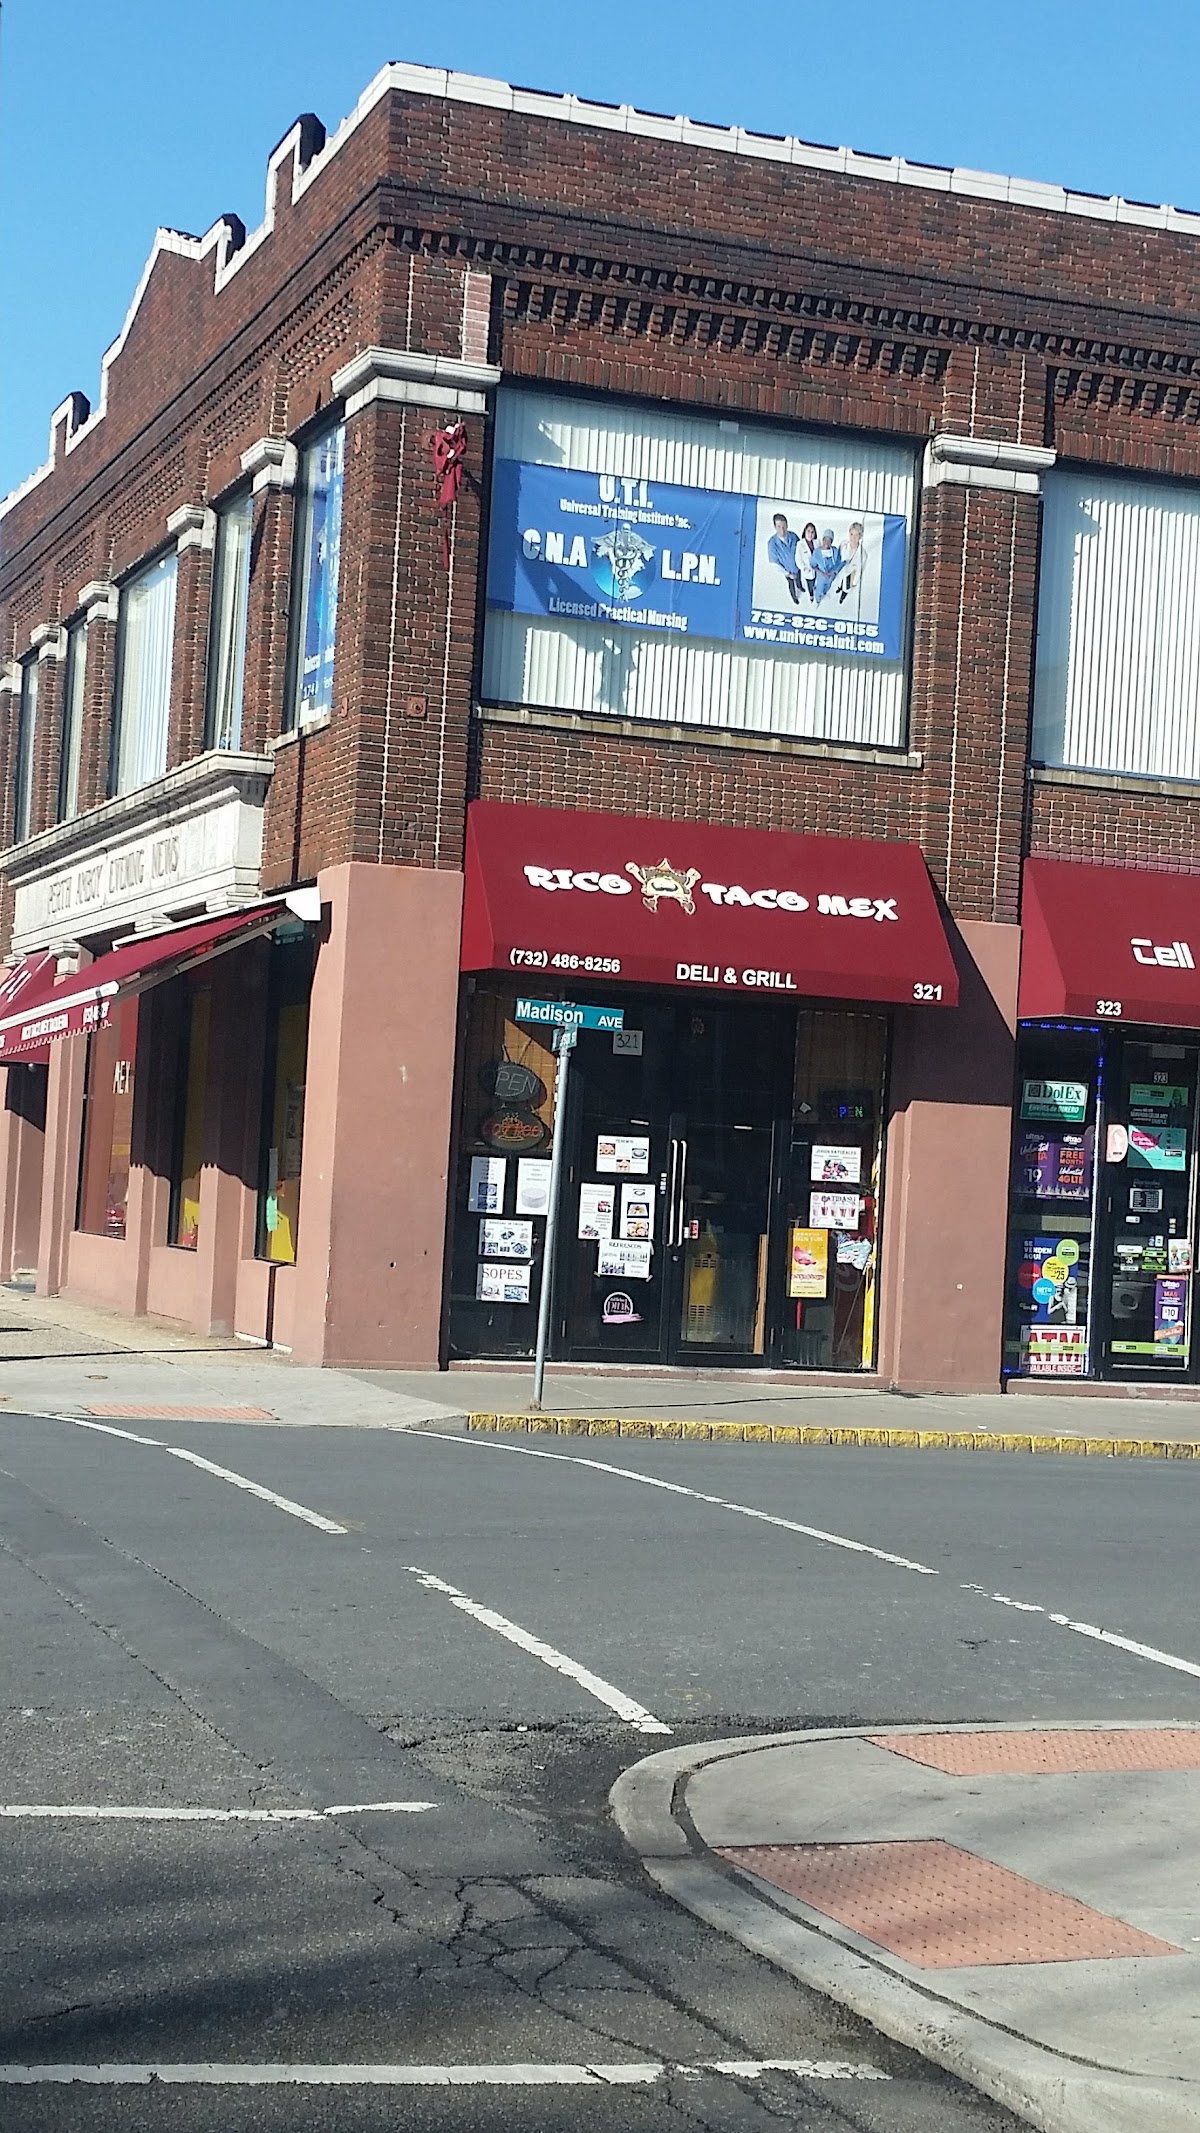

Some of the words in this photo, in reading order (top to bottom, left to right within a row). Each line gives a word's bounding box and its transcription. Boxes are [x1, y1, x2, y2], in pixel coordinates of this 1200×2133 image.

[599, 475, 653, 508] U.T.I.
[560, 498, 601, 517] Universal
[602, 504, 638, 524] Training
[638, 509, 675, 528] Institute
[675, 514, 691, 530] Inc.
[522, 529, 588, 568] C.N.A
[661, 549, 721, 586] L.P.N.
[549, 597, 597, 617] Licensed
[598, 603, 647, 624] Practical
[647, 608, 688, 632] Nursing
[151, 835, 179, 879] NEWS
[523, 865, 632, 894] RICO
[701, 882, 810, 912] TACO
[816, 893, 900, 922] MEX
[509, 947, 548, 968] (732)
[551, 954, 621, 974] 486-8256
[676, 963, 719, 984] DELI
[723, 968, 738, 984] &
[741, 970, 797, 990] GRILL
[912, 983, 943, 1001] 321
[517, 1001, 583, 1024] Madison
[598, 1015, 623, 1029] AVE
[1096, 999, 1122, 1017] 323
[616, 1033, 638, 1049] 321
[495, 1071, 537, 1094] PEN
[1043, 1085, 1081, 1100] DolEx
[1060, 1151, 1084, 1159] FREE
[483, 1268, 523, 1281] SOPES
[1023, 1333, 1080, 1361] ATM
